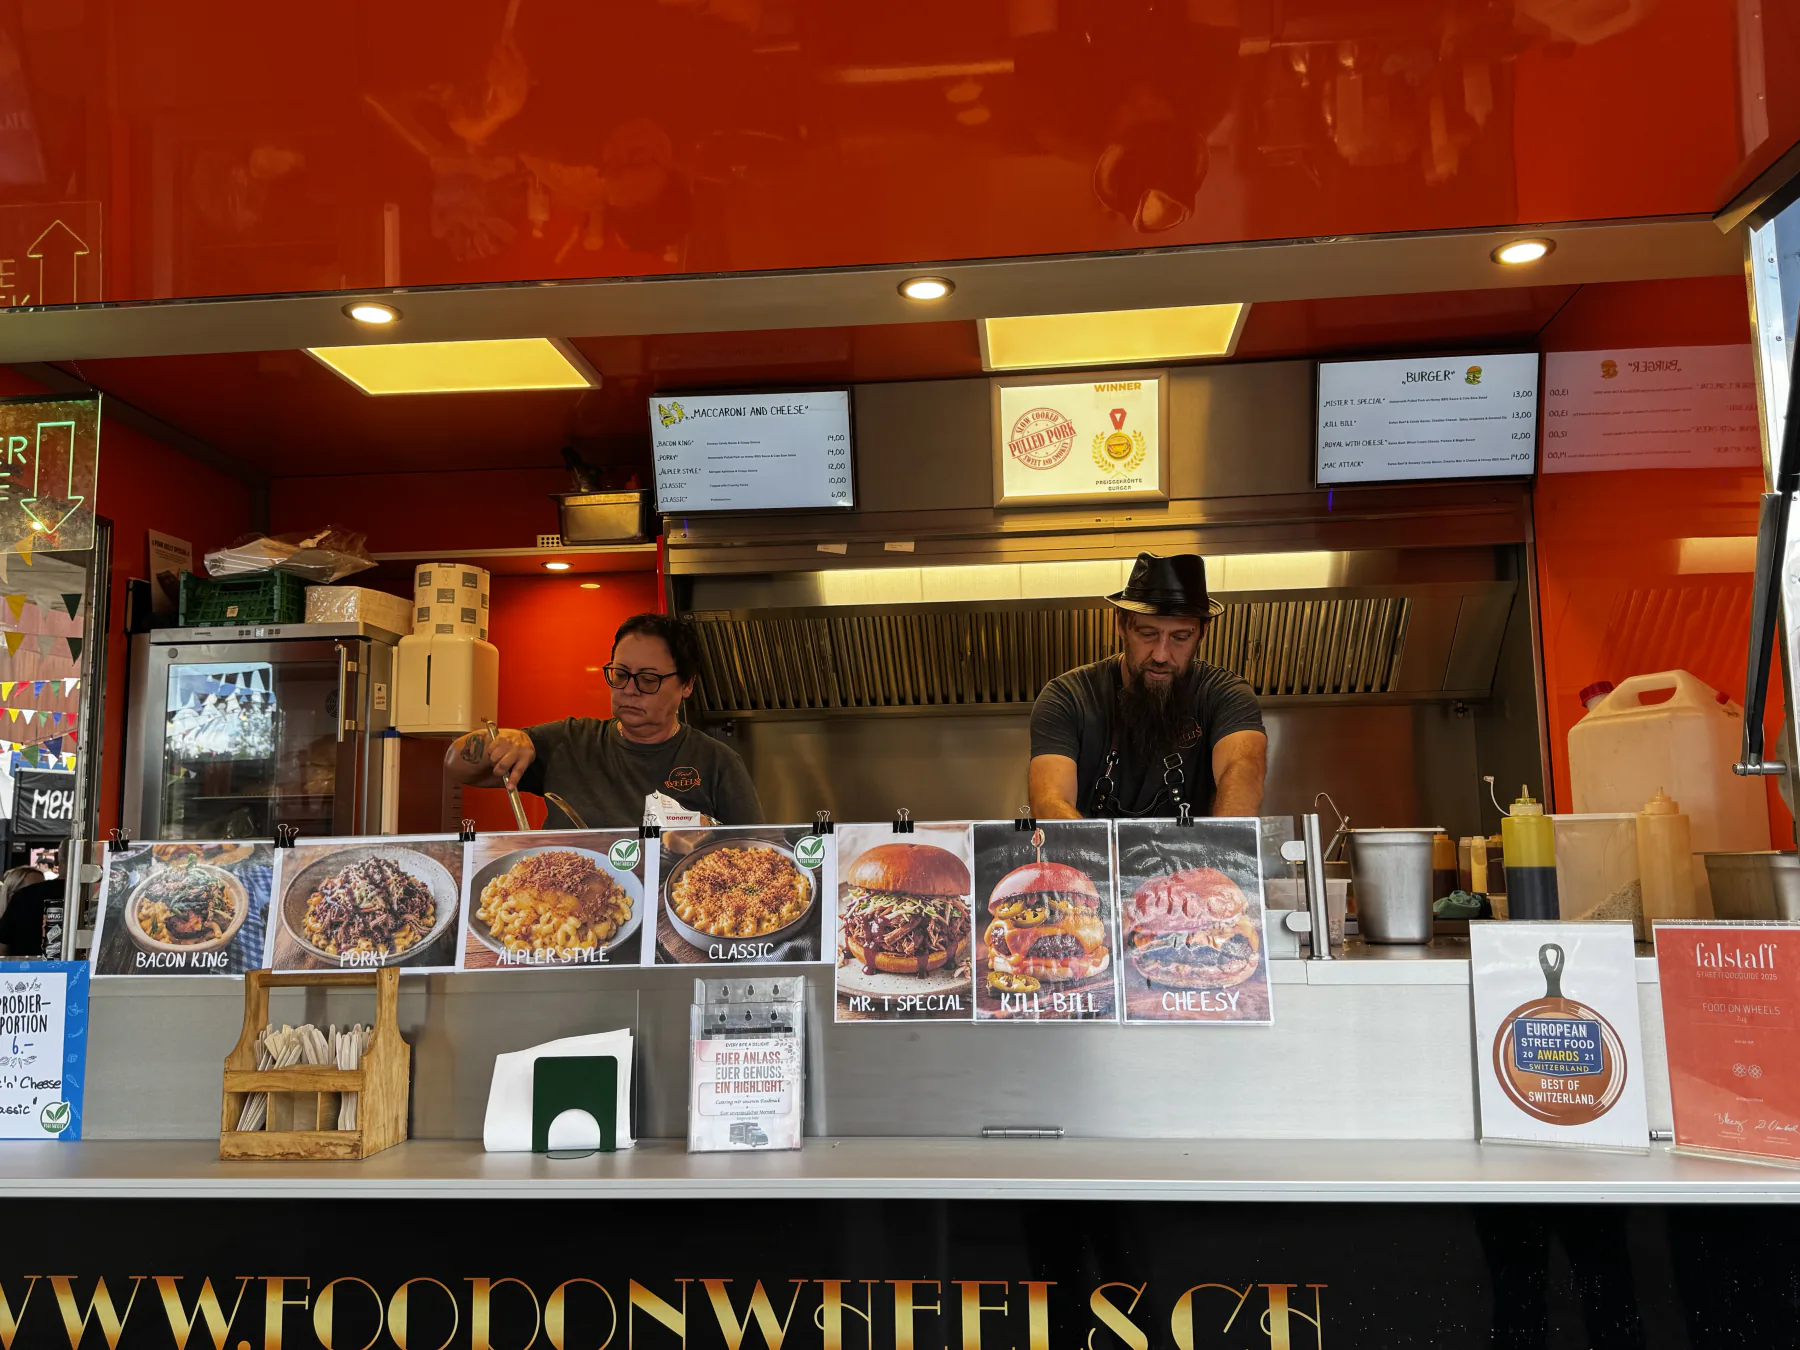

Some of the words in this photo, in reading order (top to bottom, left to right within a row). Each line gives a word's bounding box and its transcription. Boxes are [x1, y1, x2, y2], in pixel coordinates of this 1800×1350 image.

[1094, 382, 1142, 392] WINNER
[1512, 390, 1533, 398] 13,00
[750, 406, 768, 416] AND
[1512, 411, 1532, 419] 13,00
[1016, 417, 1030, 433] SLOW
[1032, 412, 1058, 422] COOKED
[1008, 433, 1045, 457] PULLED
[1046, 422, 1076, 443] PORK
[1511, 432, 1531, 440] 12,00
[1023, 455, 1041, 466] SWEET
[1510, 453, 1530, 461] 14,00
[496, 946, 559, 966] ÄLPLER
[561, 946, 609, 963] STYLE
[708, 942, 774, 960] CLASSIC
[1695, 943, 1777, 969] falstaff
[136, 952, 186, 968] BACON
[191, 952, 229, 968] KING
[340, 950, 389, 967] PORKY
[848, 997, 875, 1011] MR.
[881, 996, 891, 1010] T
[897, 994, 965, 1011] SPECIAL
[1000, 992, 1046, 1013] KILL
[1053, 992, 1100, 1013] BILL
[1162, 991, 1240, 1012] CHEESY
[1702, 1003, 1726, 1012] FOOD
[1728, 1004, 1740, 1013] ON
[1743, 1005, 1780, 1015] WHEELS
[0, 1015, 47, 1035] PORTION
[1526, 1022, 1587, 1037] EUROPEAN
[1521, 1038, 1561, 1048] STREET
[1564, 1040, 1595, 1049] FOOD
[716, 1052, 740, 1065] EUER
[744, 1051, 783, 1064] ANLASS.
[1537, 1050, 1579, 1061] AWARDS
[716, 1066, 740, 1080] EUER
[743, 1066, 784, 1079] GENUSS.
[1529, 1064, 1589, 1072] SWITZERLAND
[20, 1076, 61, 1089] Cheese
[715, 1082, 730, 1093] EIN
[734, 1080, 785, 1093] HIGHLIGHT.
[1541, 1079, 1564, 1090] BEST
[1568, 1080, 1579, 1090] OF
[1528, 1091, 1594, 1105] SWITZERLAND
